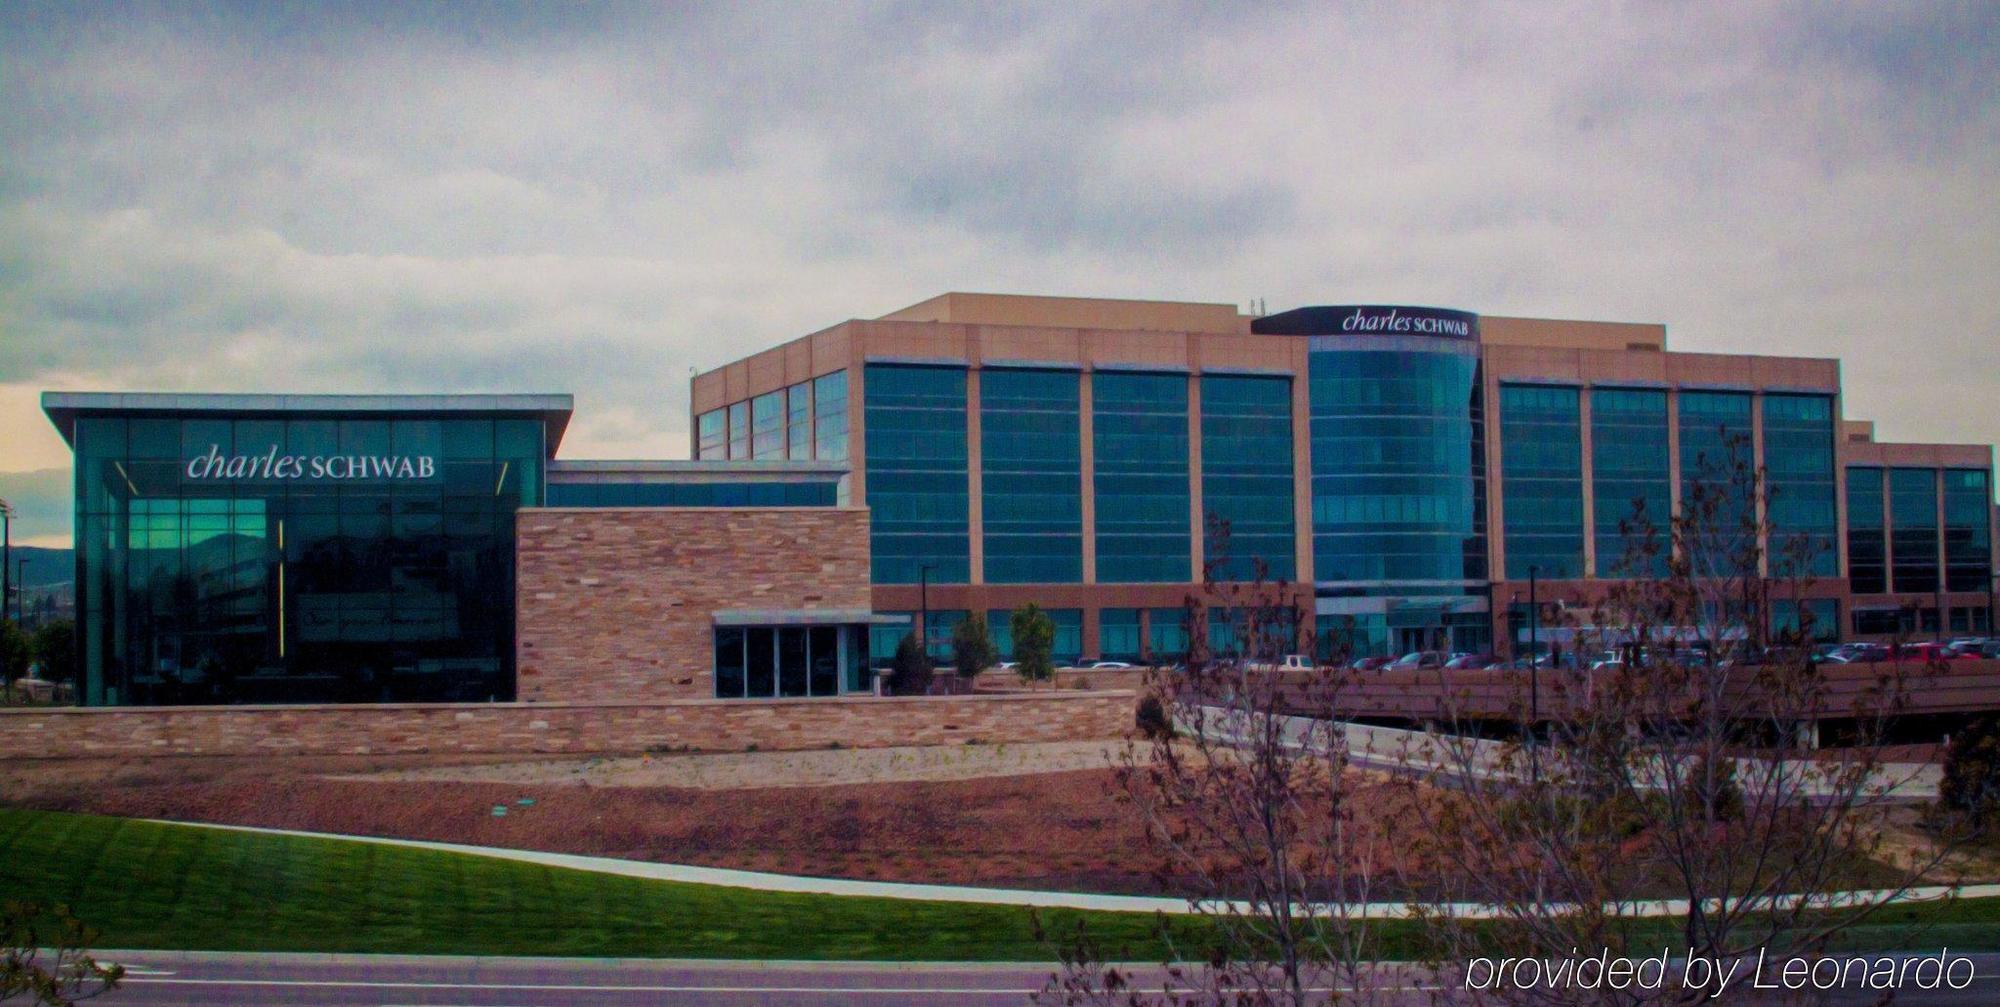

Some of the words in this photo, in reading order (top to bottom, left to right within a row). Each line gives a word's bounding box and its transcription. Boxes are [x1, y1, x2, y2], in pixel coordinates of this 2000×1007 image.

[1342, 308, 1411, 332] charles
[1413, 317, 1469, 336] SCHWAB
[187, 444, 307, 479] charles
[311, 455, 436, 479] SCHWAB
